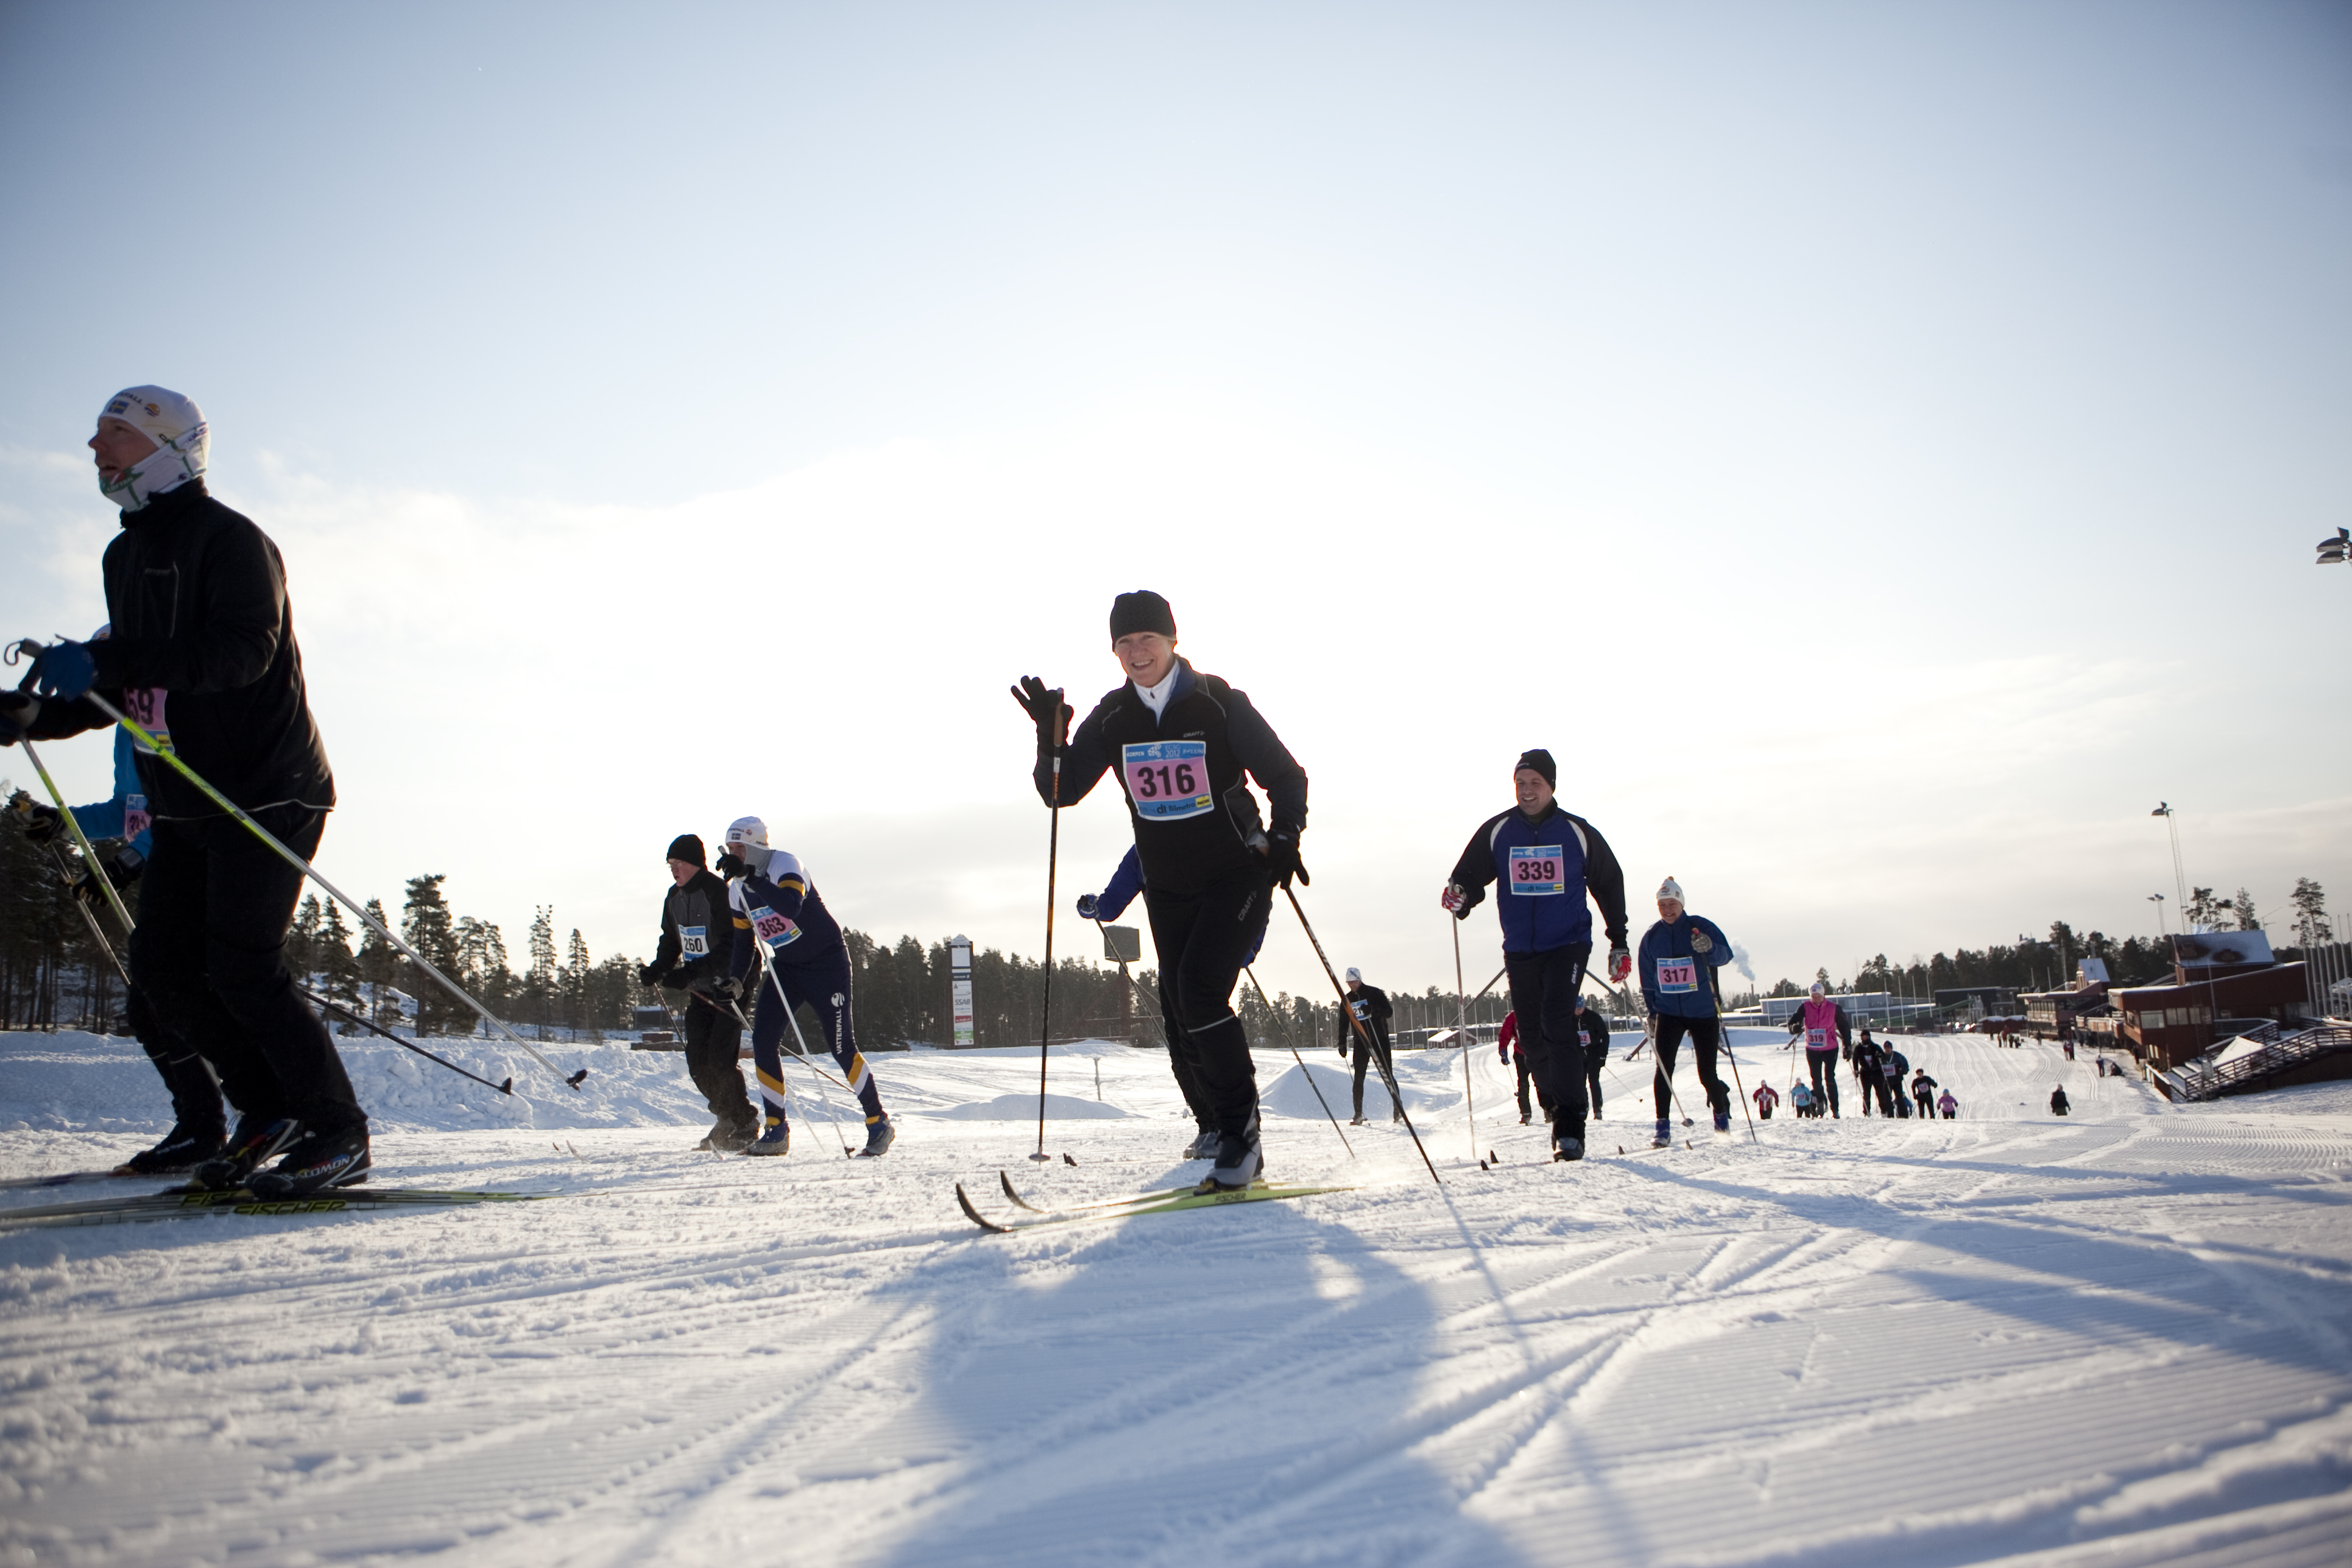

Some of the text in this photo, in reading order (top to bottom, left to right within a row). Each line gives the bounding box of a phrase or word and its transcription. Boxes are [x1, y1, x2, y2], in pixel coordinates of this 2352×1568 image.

[1137, 763, 1196, 798] 316
[1168, 802, 1195, 811] Bilmetro
[1517, 860, 1555, 881] 339
[1238, 894, 1254, 922] CRAFT
[757, 916, 786, 938] 363
[683, 936, 703, 952] 260
[1662, 967, 1688, 983] 317
[1809, 1034, 1823, 1042] 319
[282, 1155, 350, 1181] SALOMON
[1215, 1192, 1247, 1202] FISCHER
[234, 1199, 347, 1215] FISCHER
